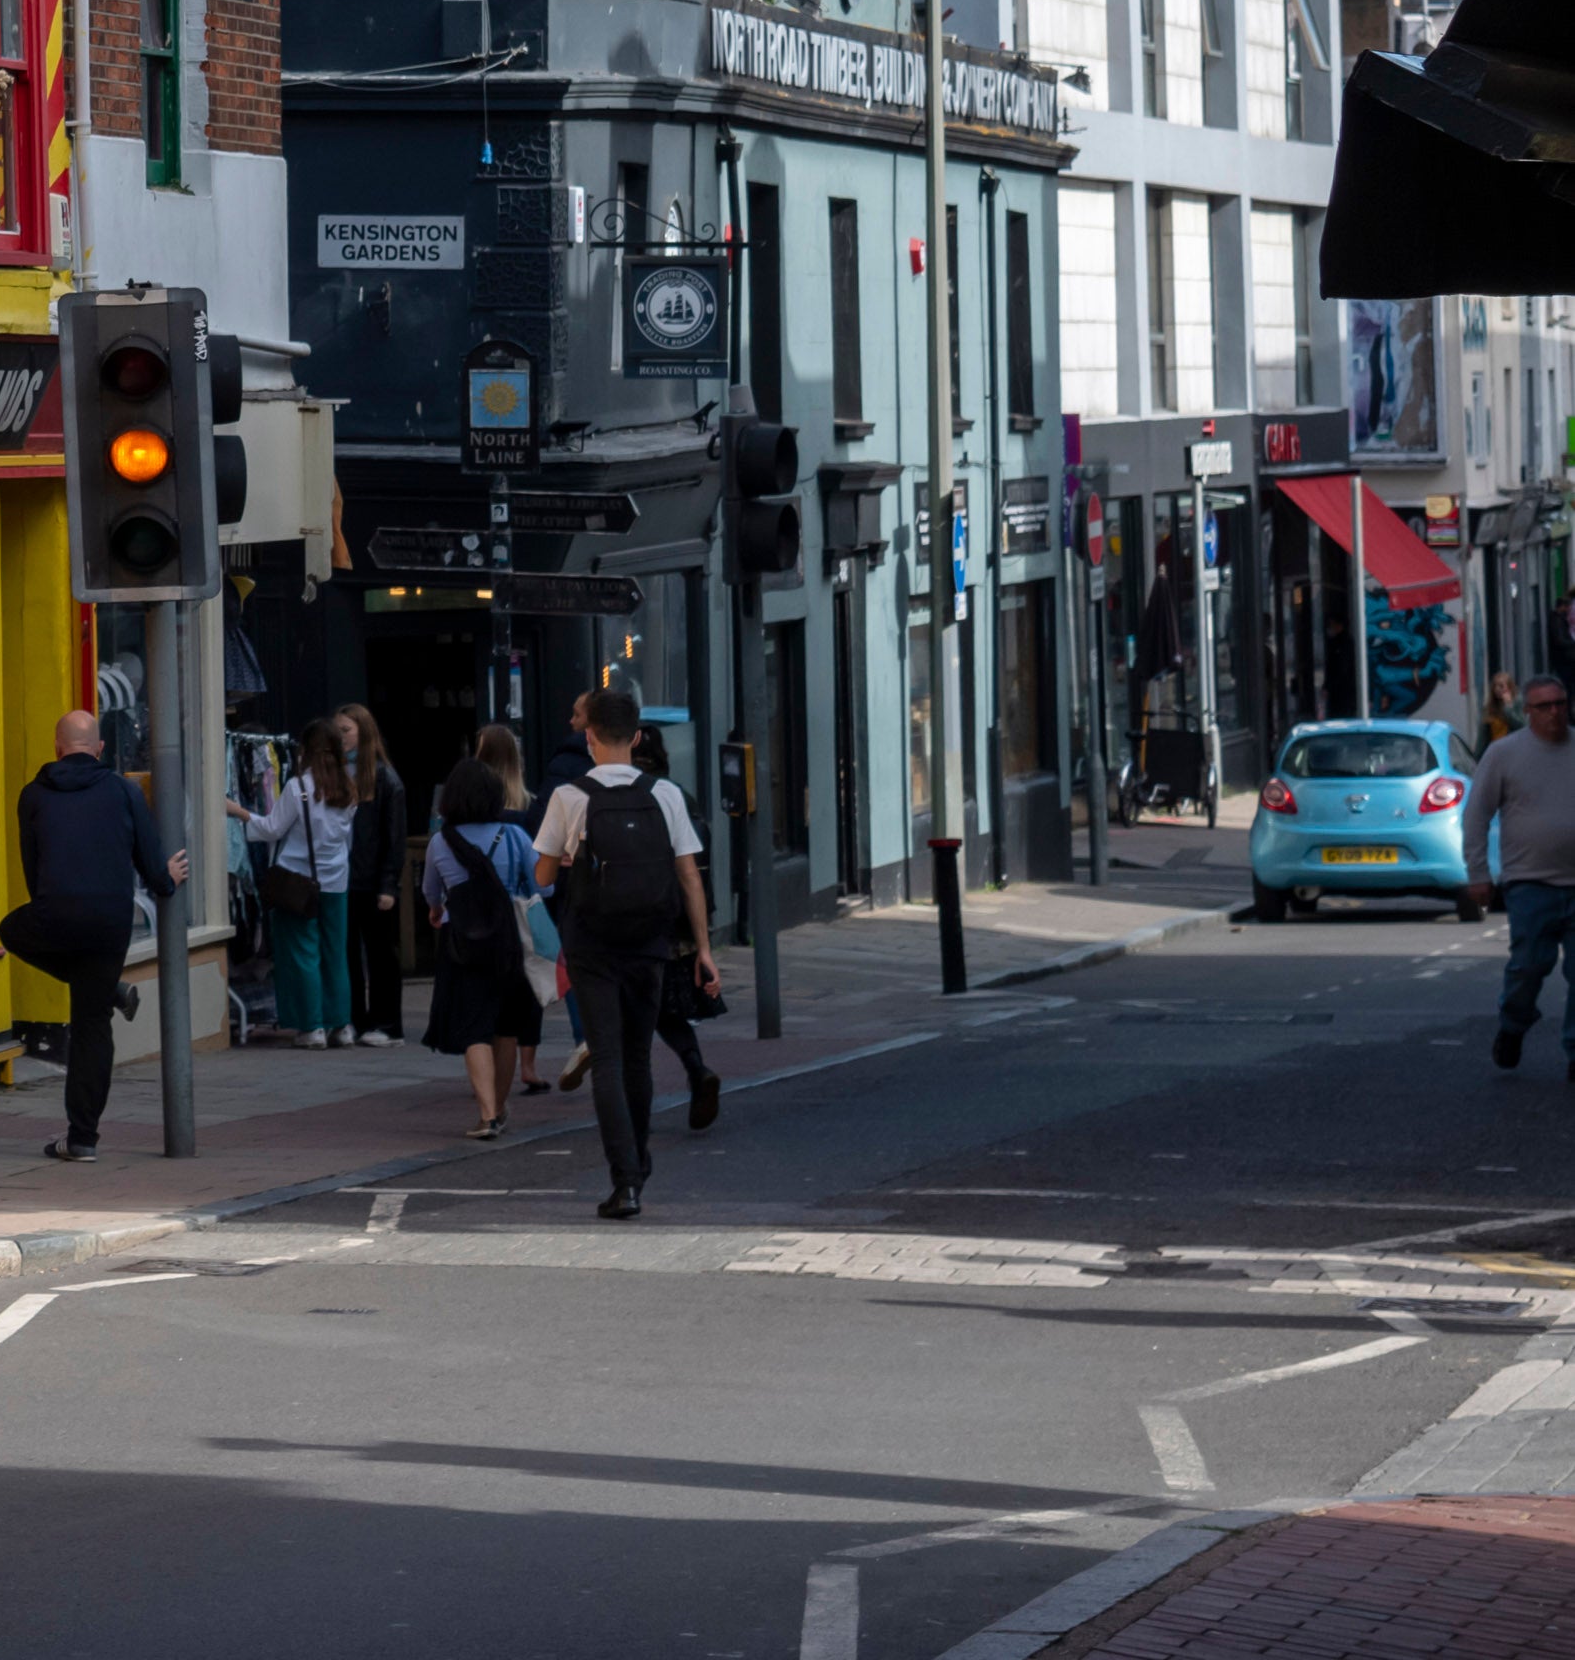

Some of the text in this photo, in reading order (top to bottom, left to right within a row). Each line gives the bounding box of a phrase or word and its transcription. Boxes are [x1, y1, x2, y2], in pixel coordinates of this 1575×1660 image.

[712, 6, 763, 79] NORTH
[765, 22, 810, 88] ROAD
[810, 31, 872, 109] TIMBER,
[872, 44, 926, 110] BUILDIN
[953, 60, 1003, 122] JOINERY
[1003, 71, 1058, 133] COMPANY
[324, 223, 458, 243] KENSINGTON
[341, 243, 441, 262] GARDENS
[643, 271, 709, 293] TRADING POST
[642, 322, 709, 346] COFFEE ROASTERS
[639, 365, 712, 376] ROASTING CO.
